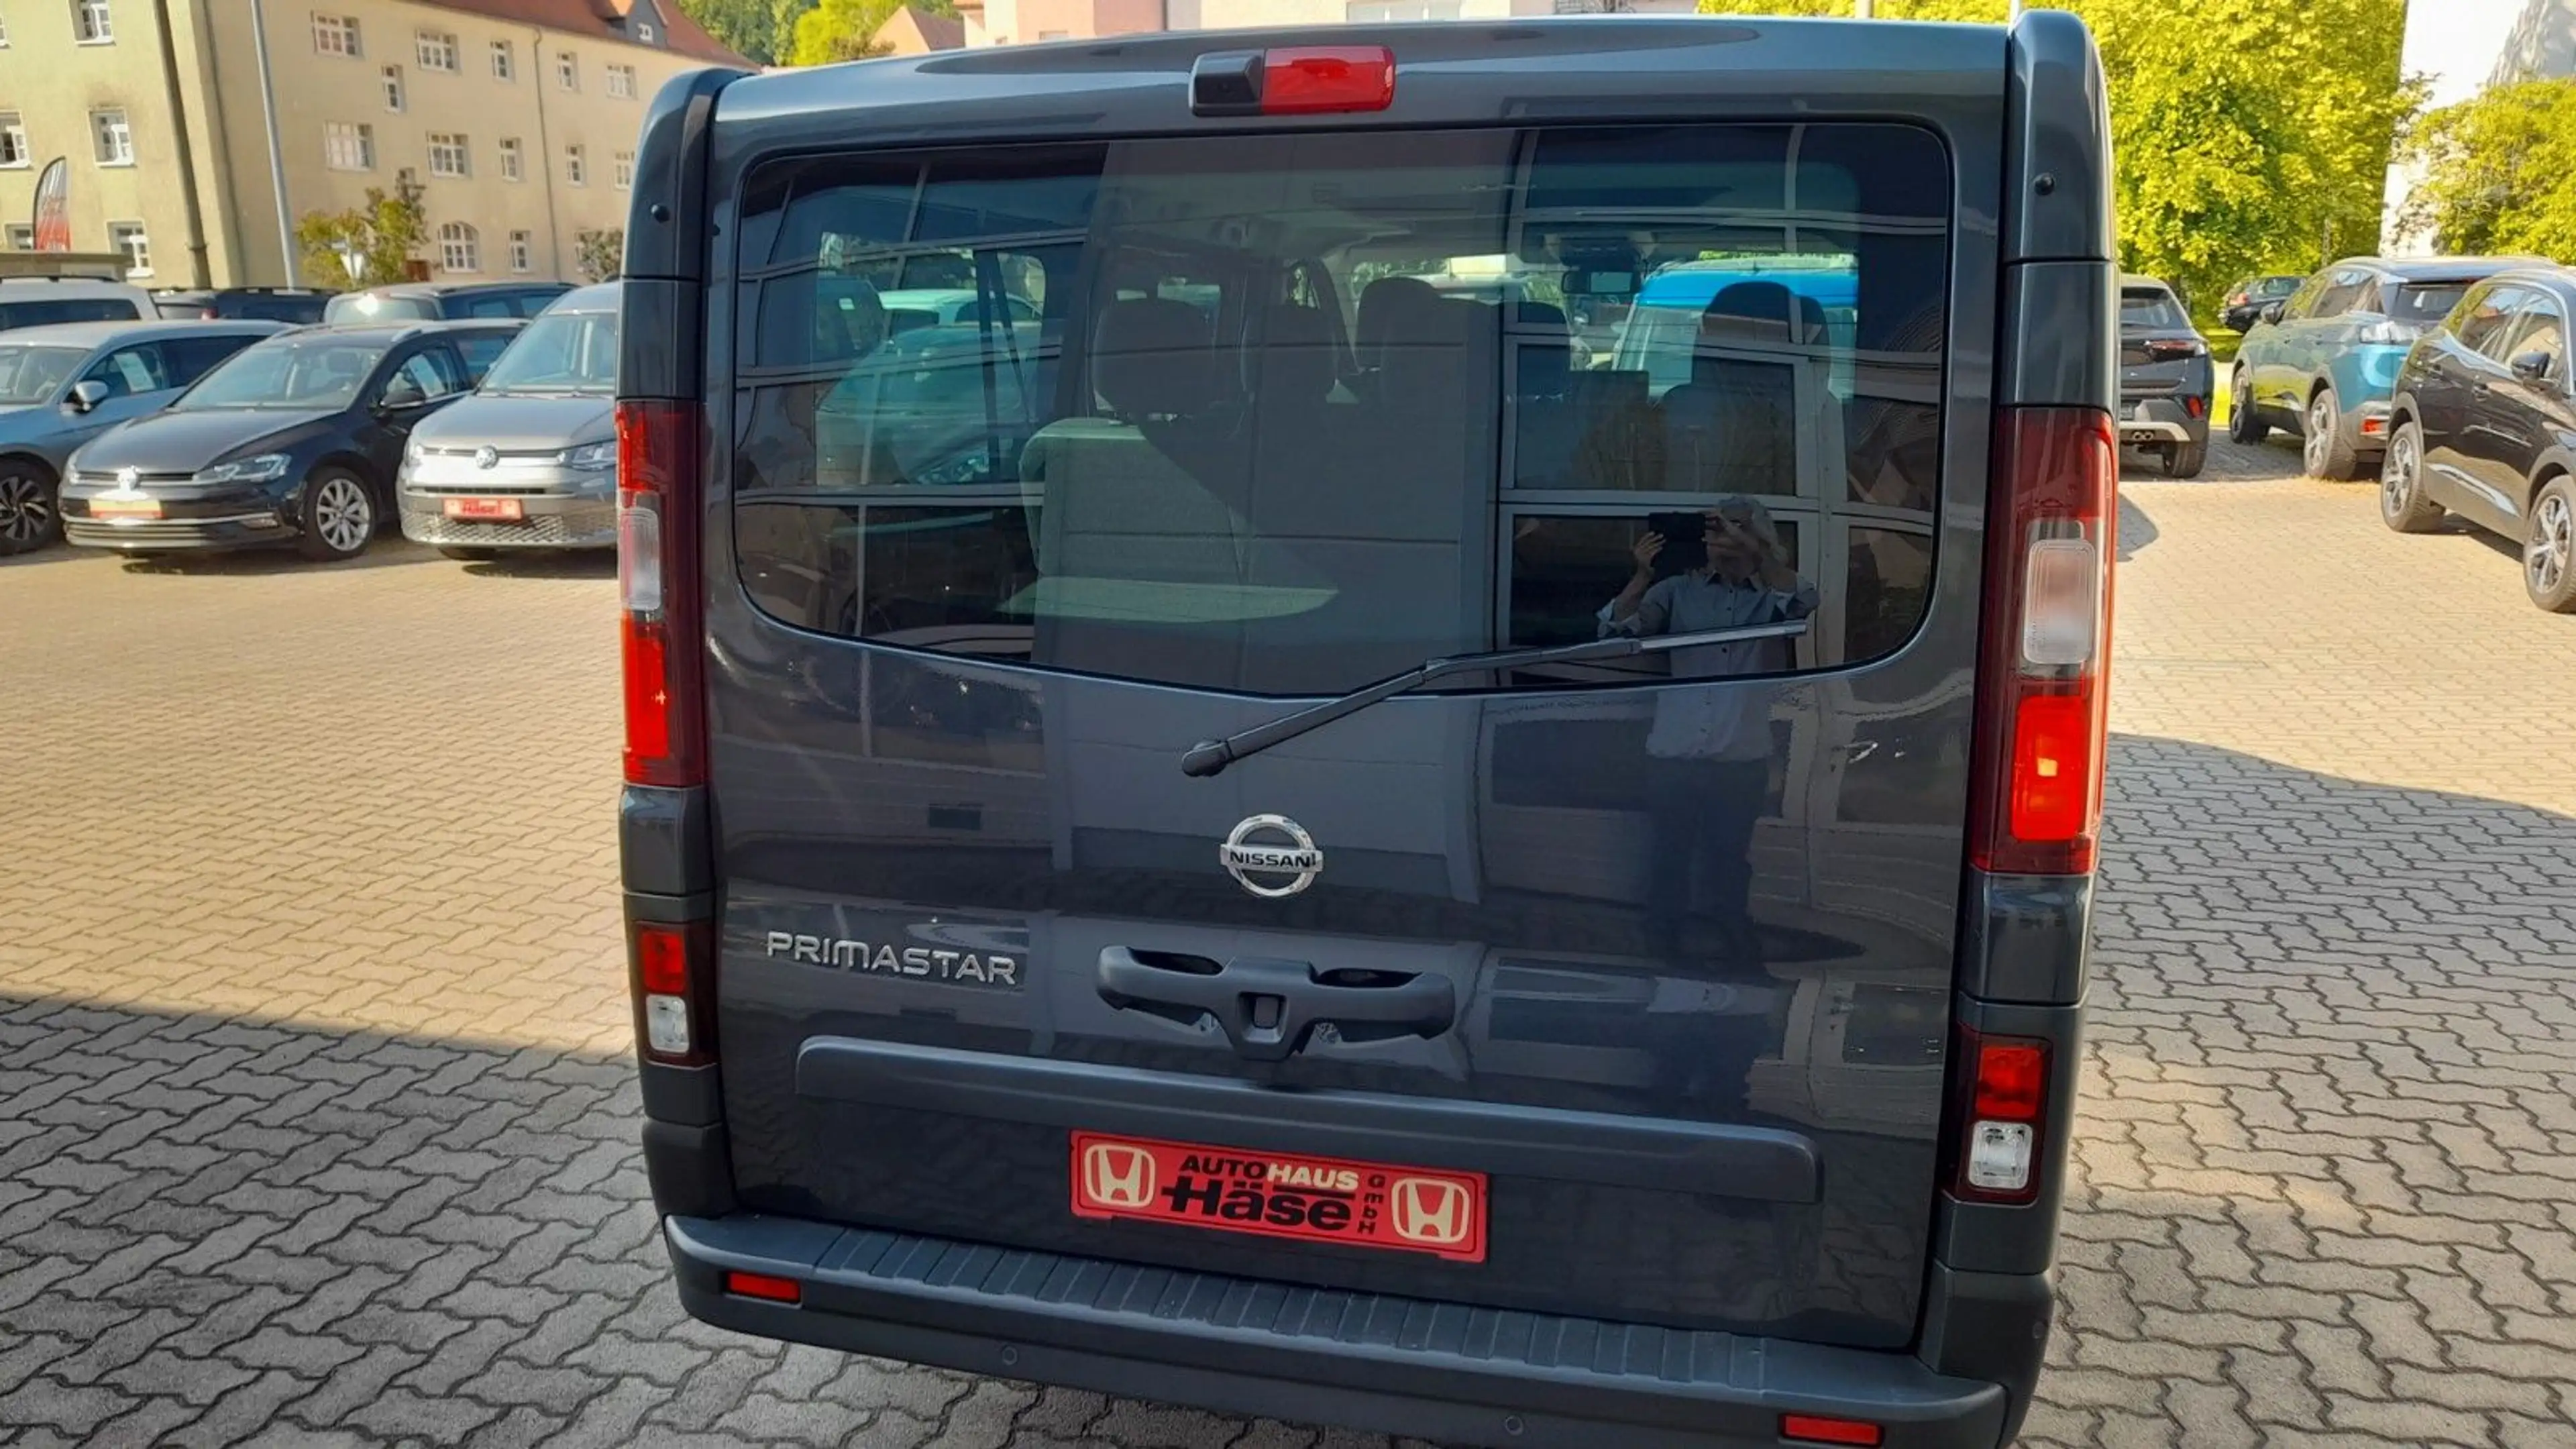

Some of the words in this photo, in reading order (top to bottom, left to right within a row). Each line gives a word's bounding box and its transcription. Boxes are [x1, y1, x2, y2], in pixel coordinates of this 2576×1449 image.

[1230, 851, 1316, 868] NISSAN
[767, 930, 1016, 985] PRIMASTAR
[1179, 1155, 1360, 1191] AUTOHAUS
[1161, 1175, 1351, 1231] Häse
